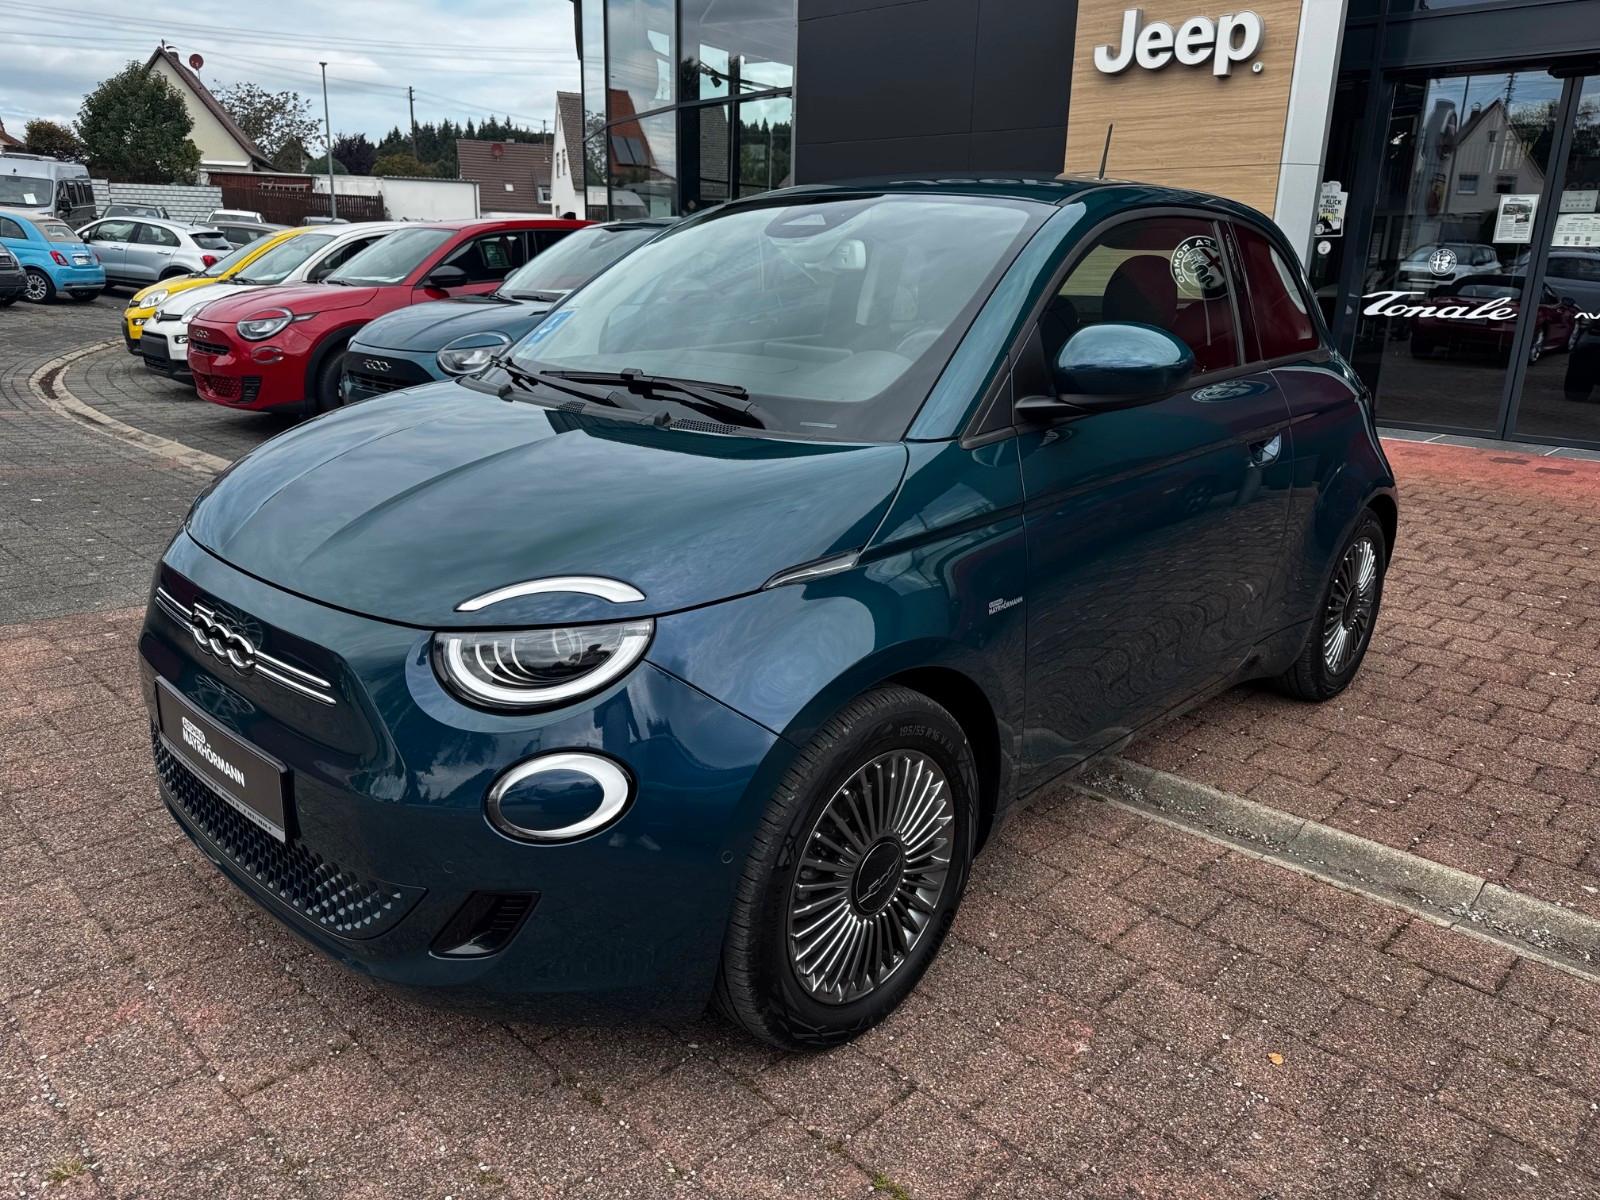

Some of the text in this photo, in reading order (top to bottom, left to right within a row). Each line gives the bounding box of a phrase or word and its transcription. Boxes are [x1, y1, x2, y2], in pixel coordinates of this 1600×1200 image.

[1094, 8, 1265, 77] Jeep
[1362, 290, 1519, 320] Tonale
[182, 727, 245, 788] MAYRHÖRMANN
